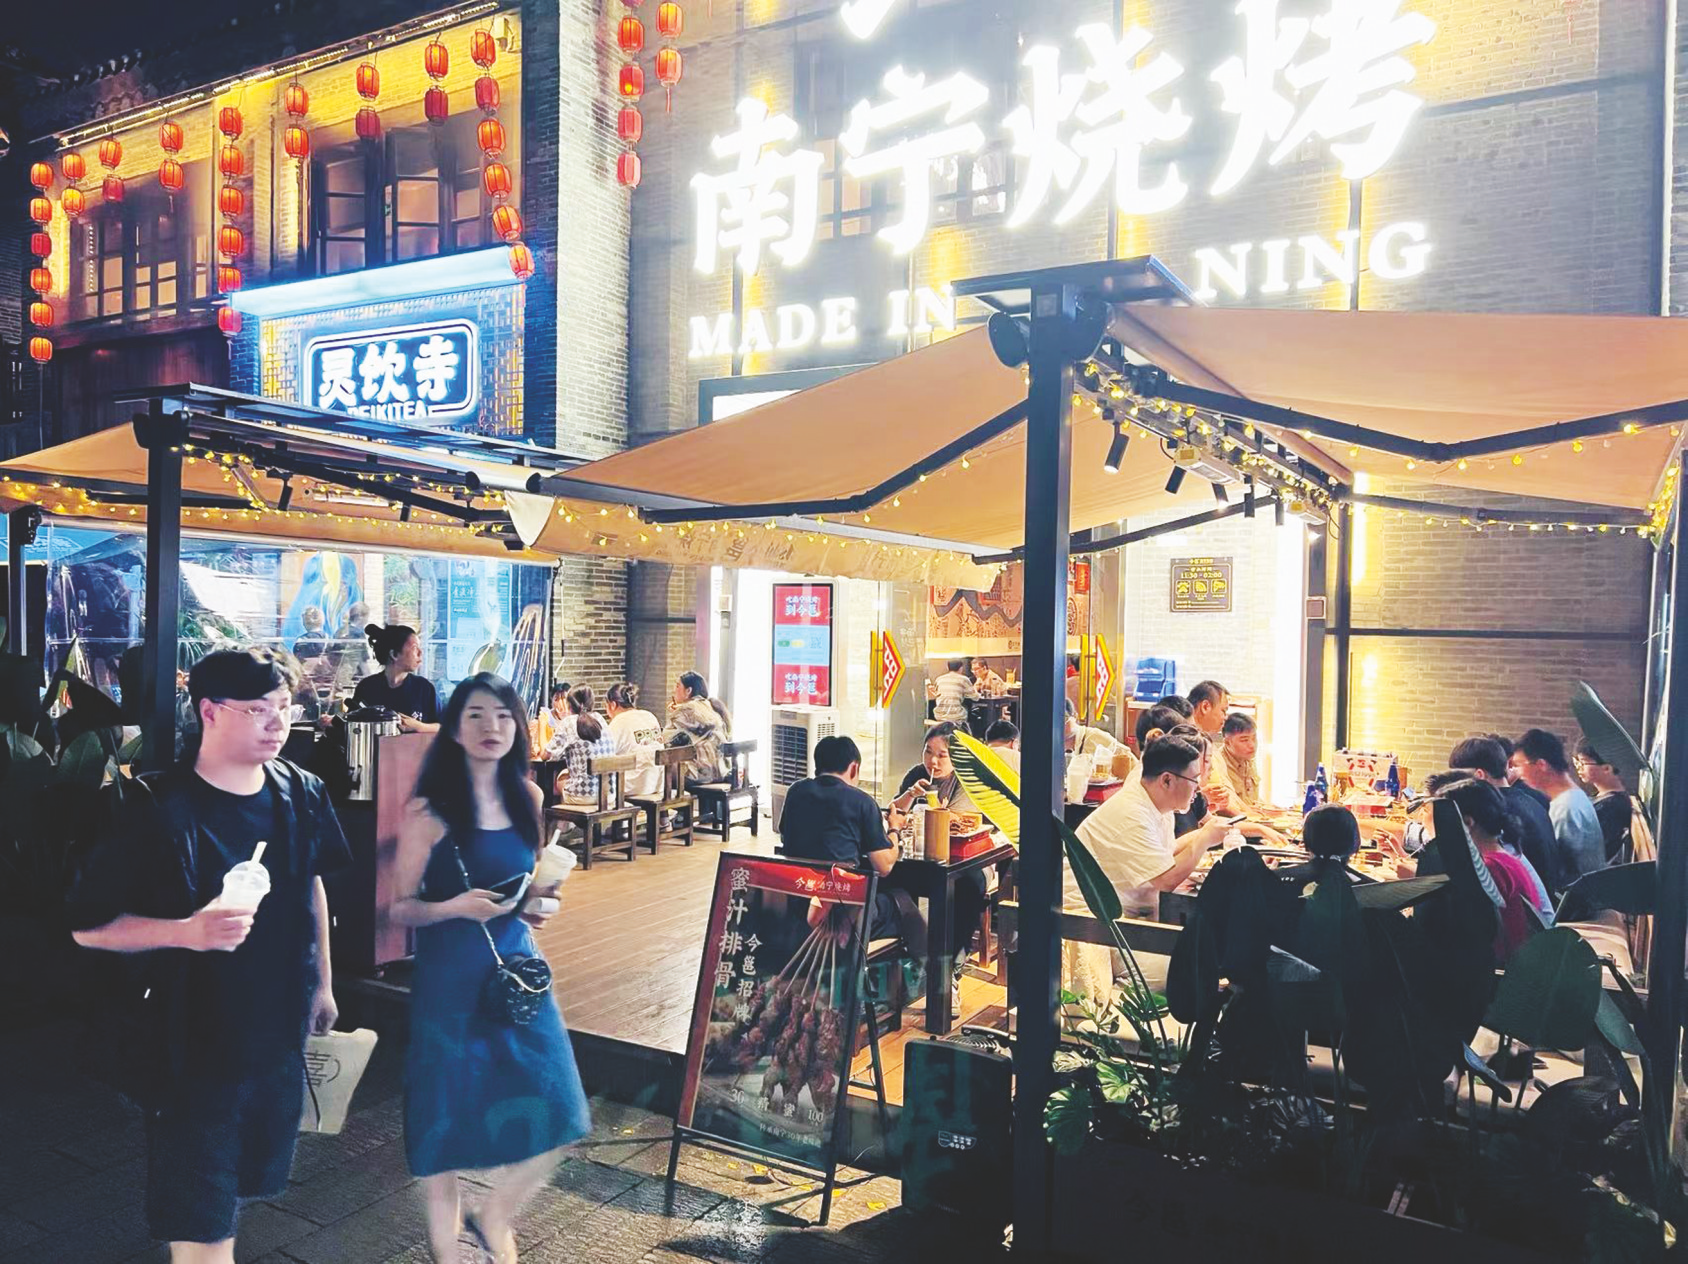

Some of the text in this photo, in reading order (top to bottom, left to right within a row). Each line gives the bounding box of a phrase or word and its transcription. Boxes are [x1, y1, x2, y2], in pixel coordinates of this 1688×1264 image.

[688, 0, 1436, 274] 南宁烧烤
[689, 222, 1434, 358] MADE IN NING
[318, 334, 460, 409] 灵饮寺
[714, 867, 750, 990] 蜜汁排骨
[808, 1109, 824, 1123] 100
